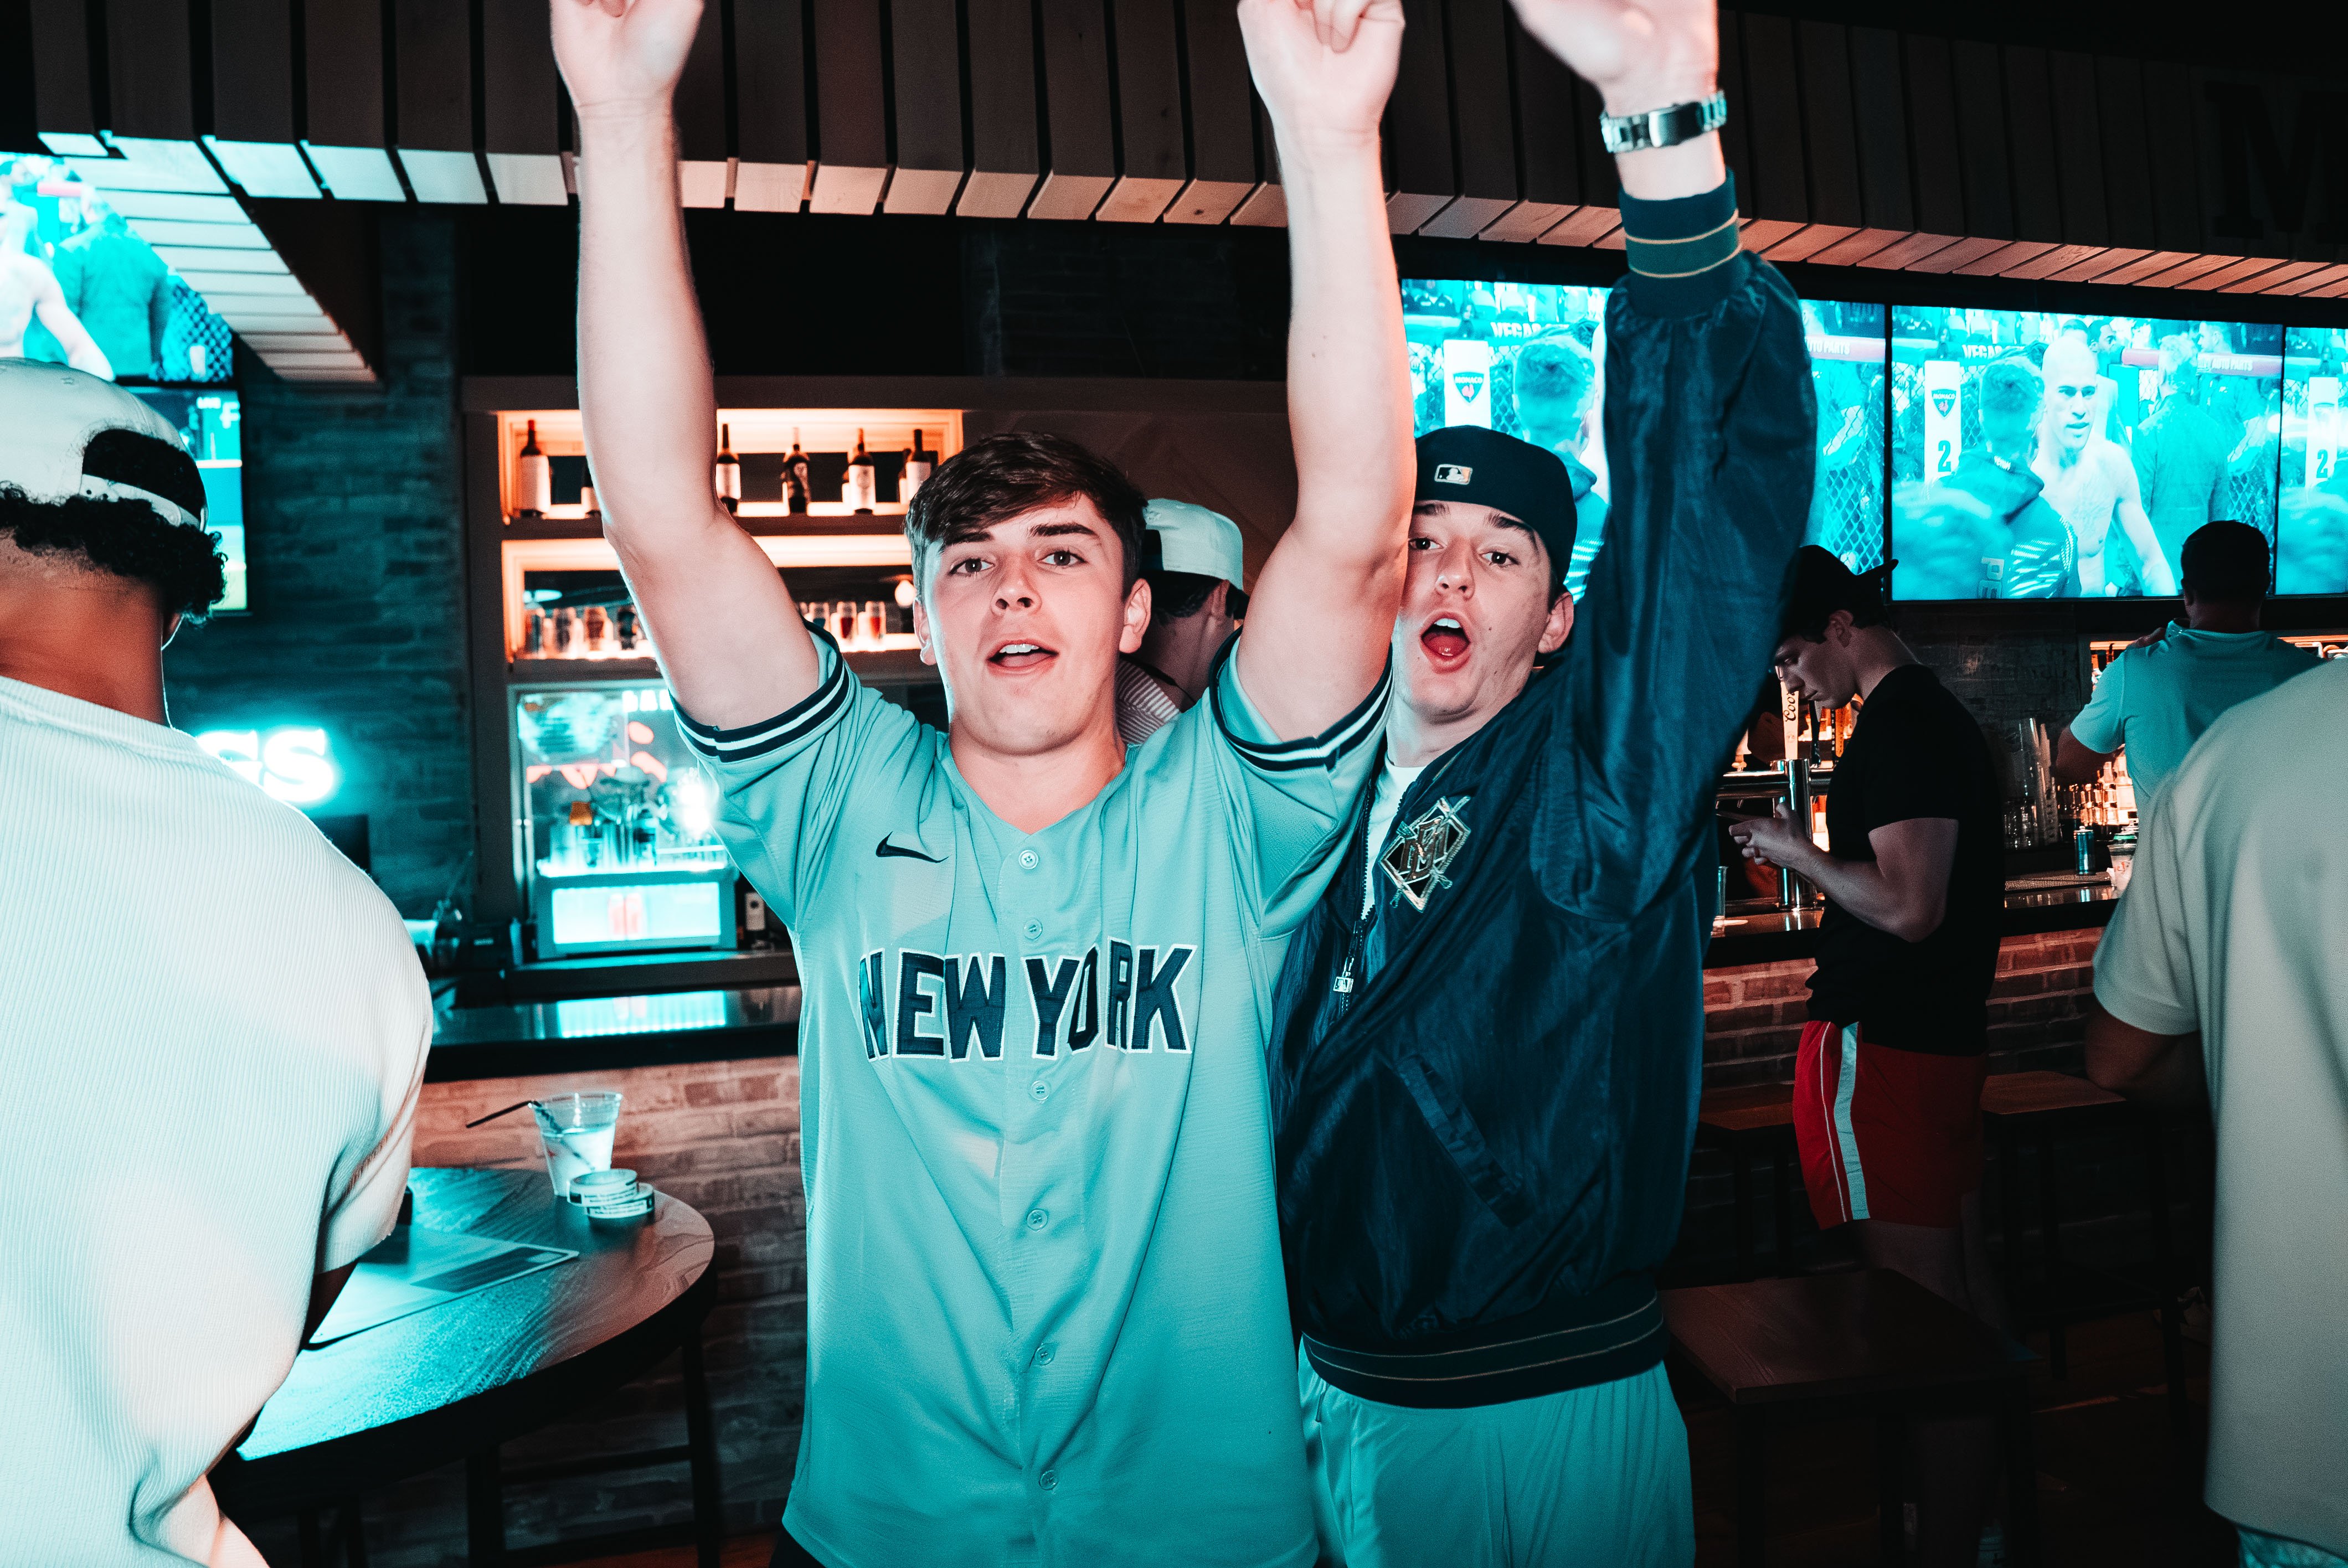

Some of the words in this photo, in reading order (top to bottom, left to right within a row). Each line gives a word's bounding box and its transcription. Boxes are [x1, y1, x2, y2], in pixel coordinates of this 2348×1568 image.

[1805, 338, 1822, 352] UTO
[1824, 341, 1850, 355] PARTS
[1938, 440, 1951, 473] 2
[2316, 449, 2329, 478] 2
[858, 947, 1007, 1063] NEW
[1021, 936, 1197, 1061] YORK
